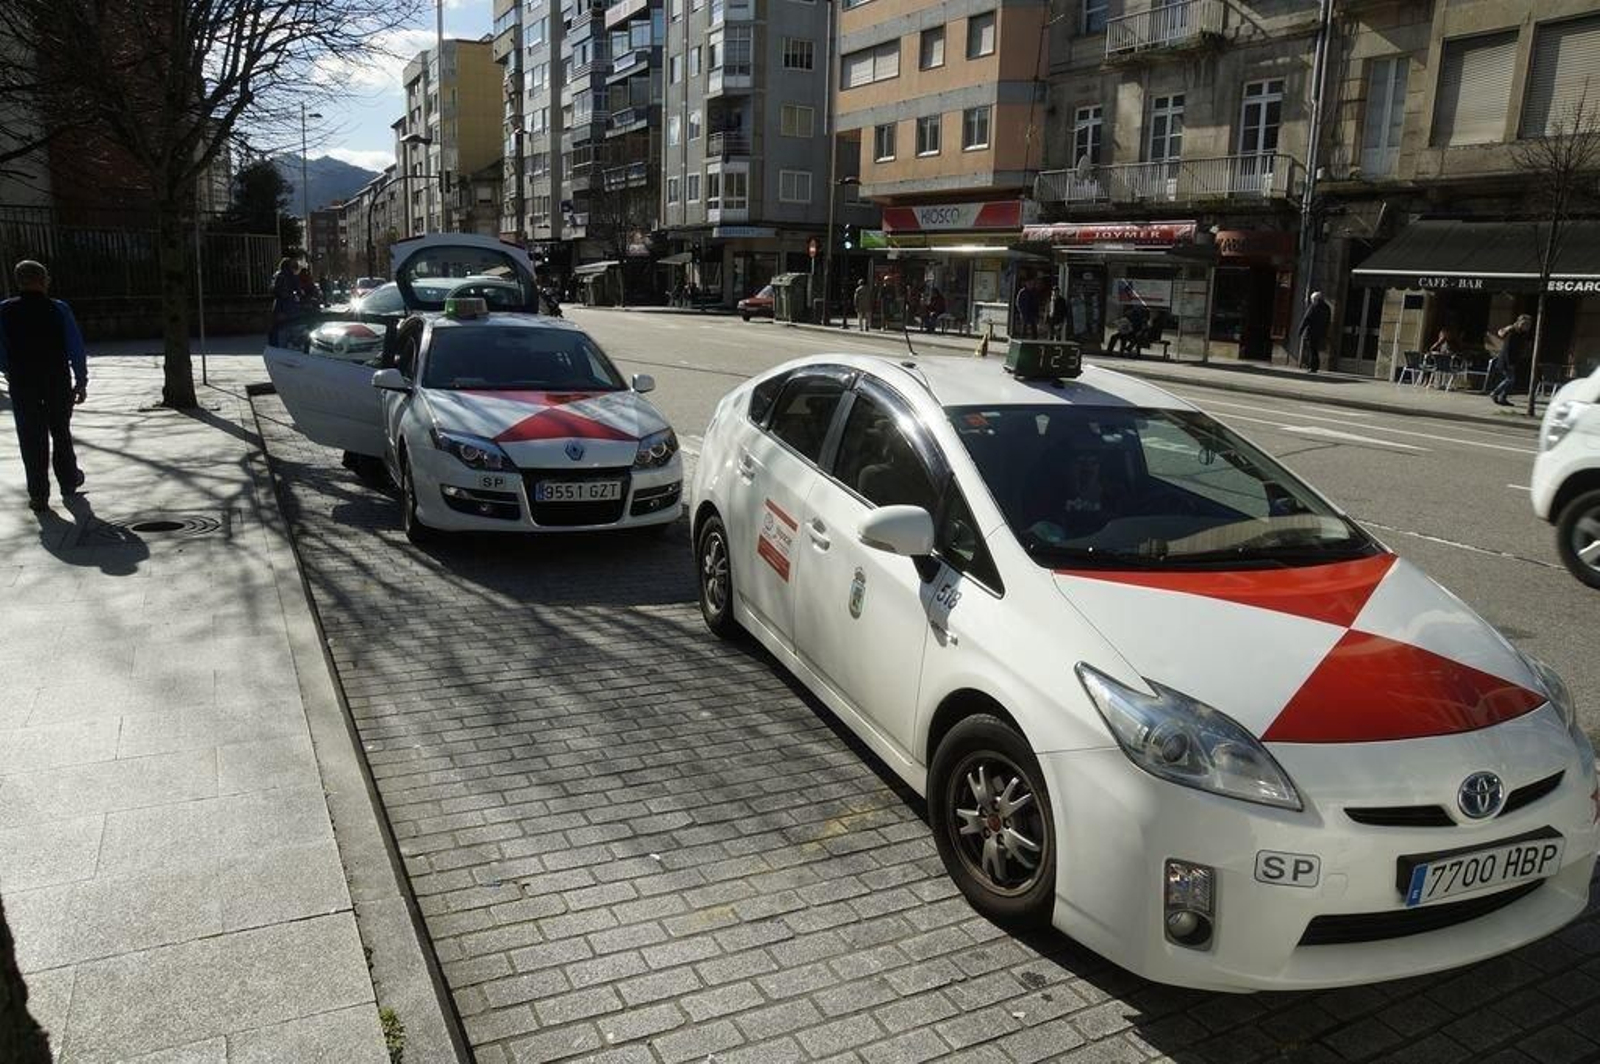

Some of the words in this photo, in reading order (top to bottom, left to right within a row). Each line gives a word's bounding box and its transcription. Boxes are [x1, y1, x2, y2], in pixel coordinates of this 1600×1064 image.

[921, 207, 960, 225] KIOSCO
[1094, 231, 1161, 239] JOYMER
[1458, 278, 1484, 289] BAR
[483, 476, 504, 488] SP
[545, 485, 582, 499] 9551
[590, 483, 617, 498] GZT
[1261, 856, 1315, 882] SP
[1427, 854, 1497, 898] 7700
[1502, 844, 1558, 880] HBP
